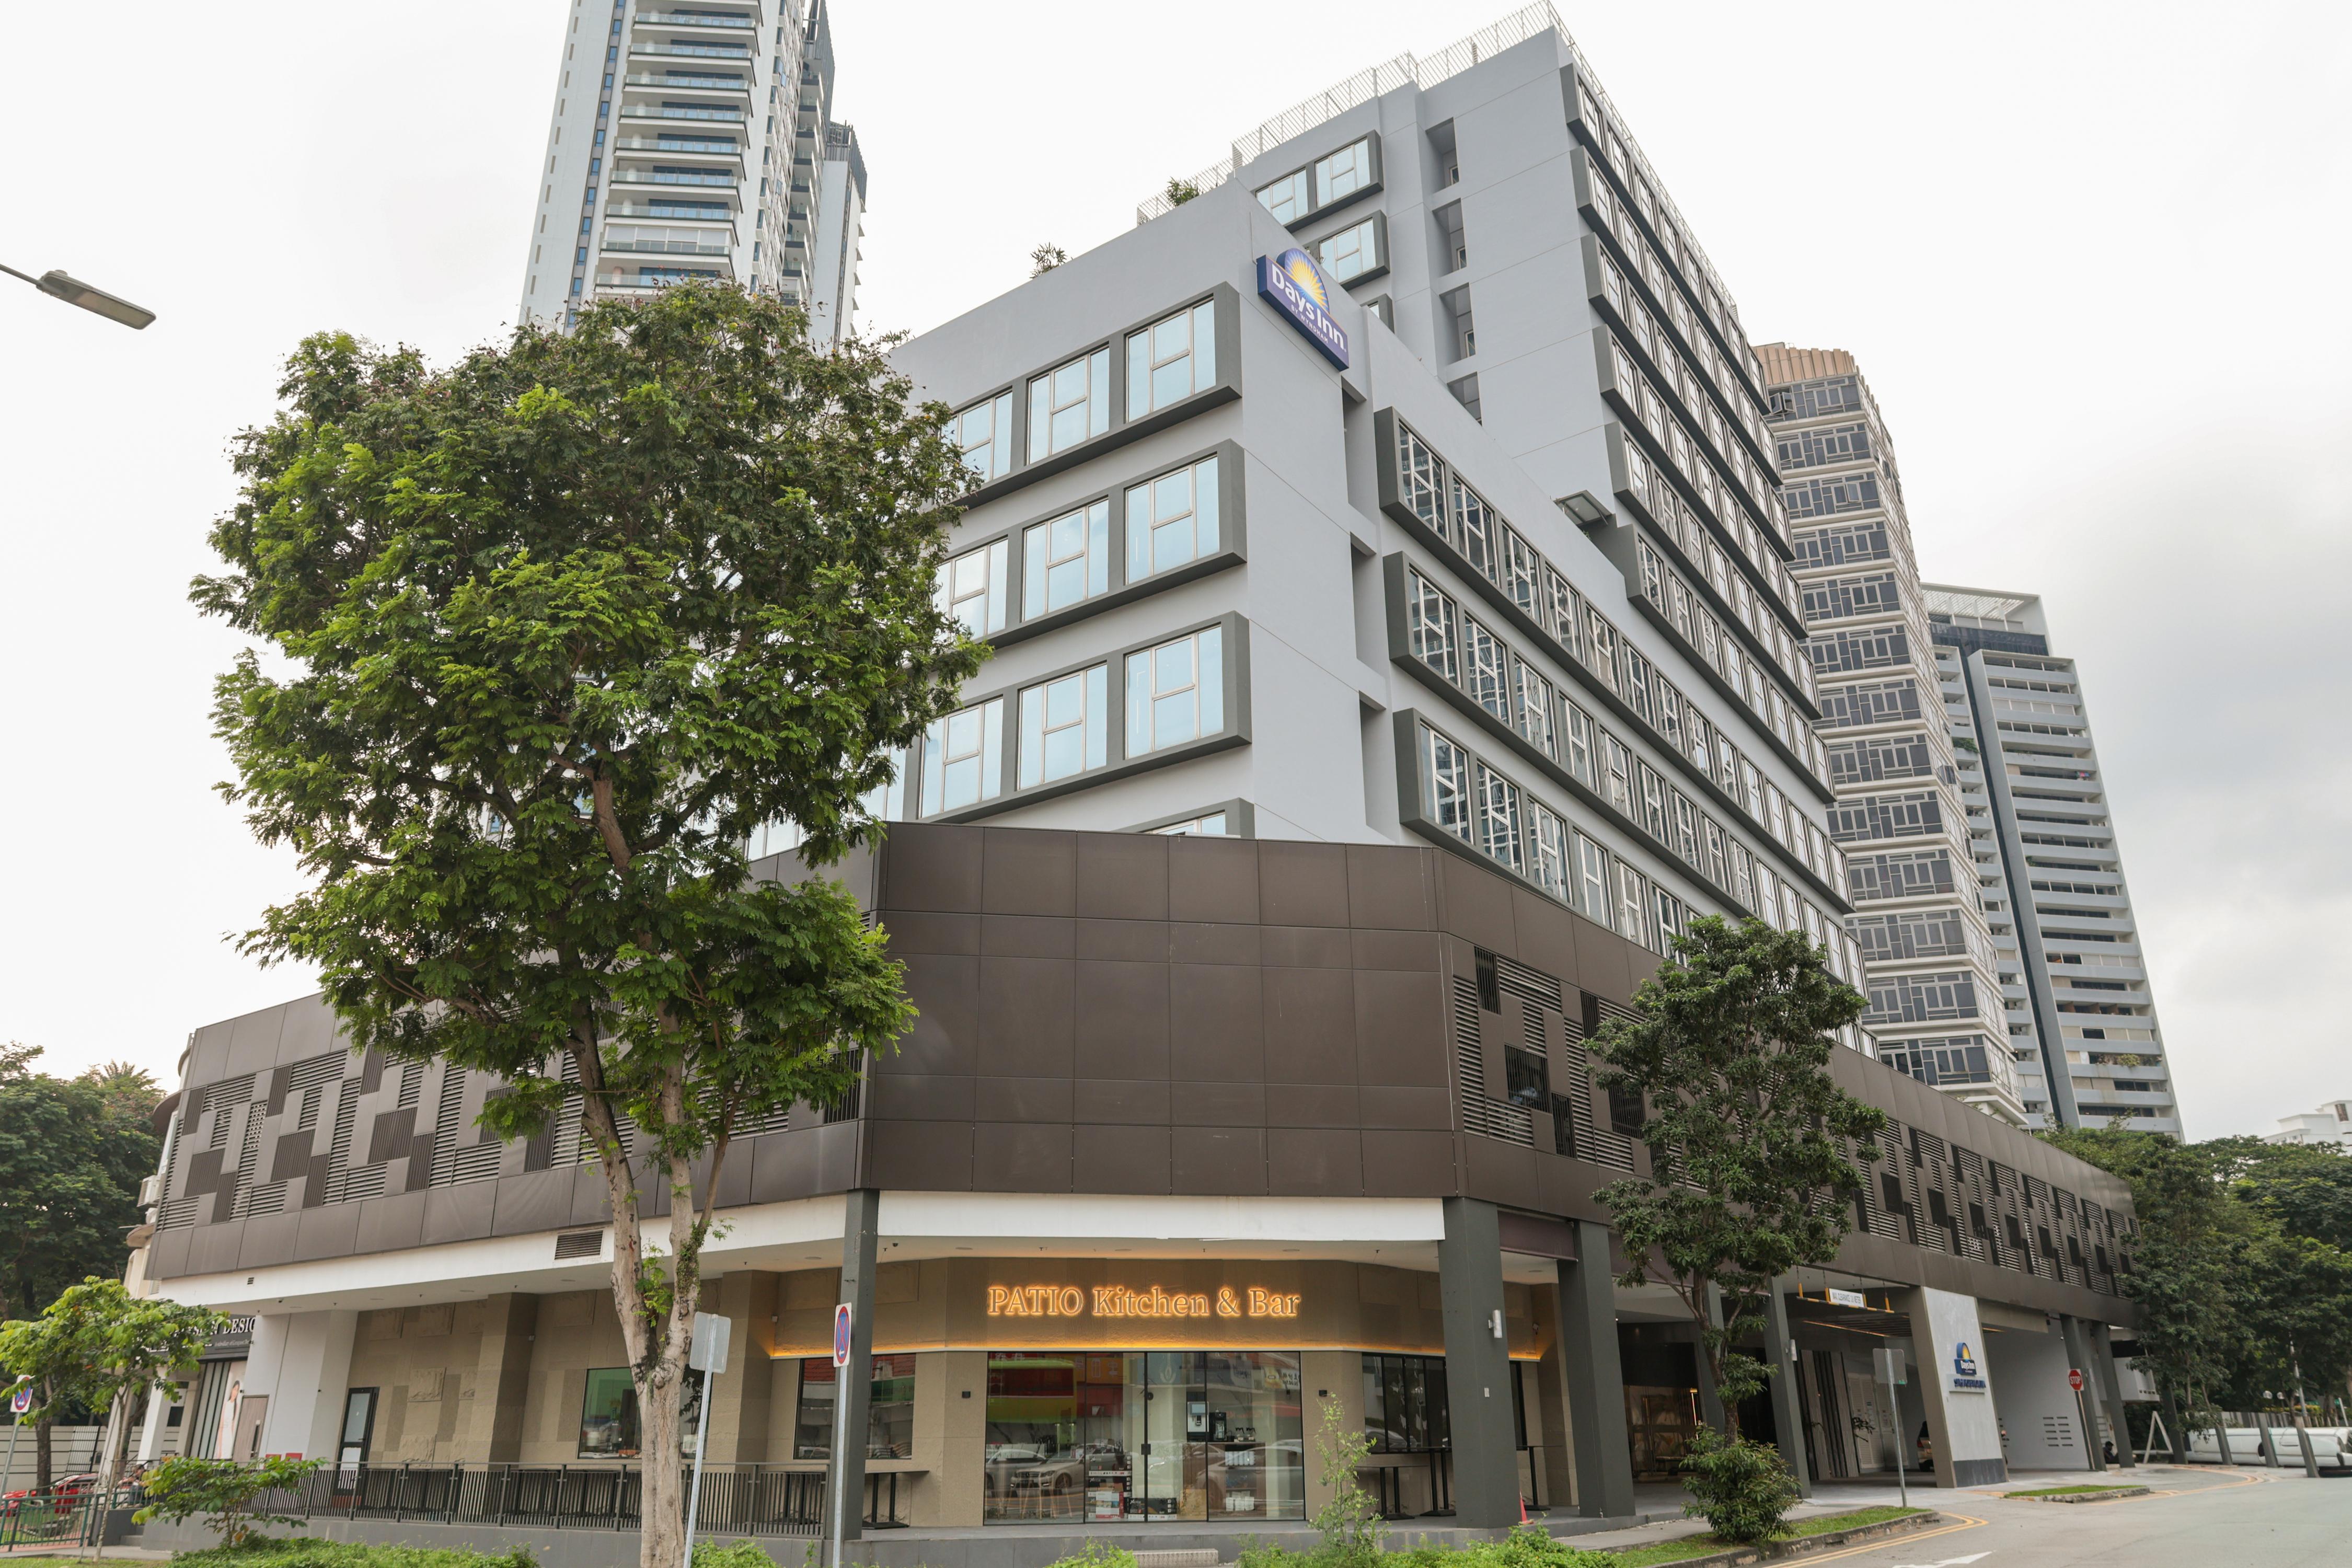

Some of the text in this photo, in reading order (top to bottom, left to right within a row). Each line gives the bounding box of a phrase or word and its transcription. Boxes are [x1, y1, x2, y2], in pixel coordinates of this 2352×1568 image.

[1272, 263, 1345, 350] Days Inn
[1291, 304, 1329, 344] BY WYNDHAM
[988, 1286, 1301, 1316] PATIO Kitchen & Bar
[2070, 1376, 2081, 1385] STOP
